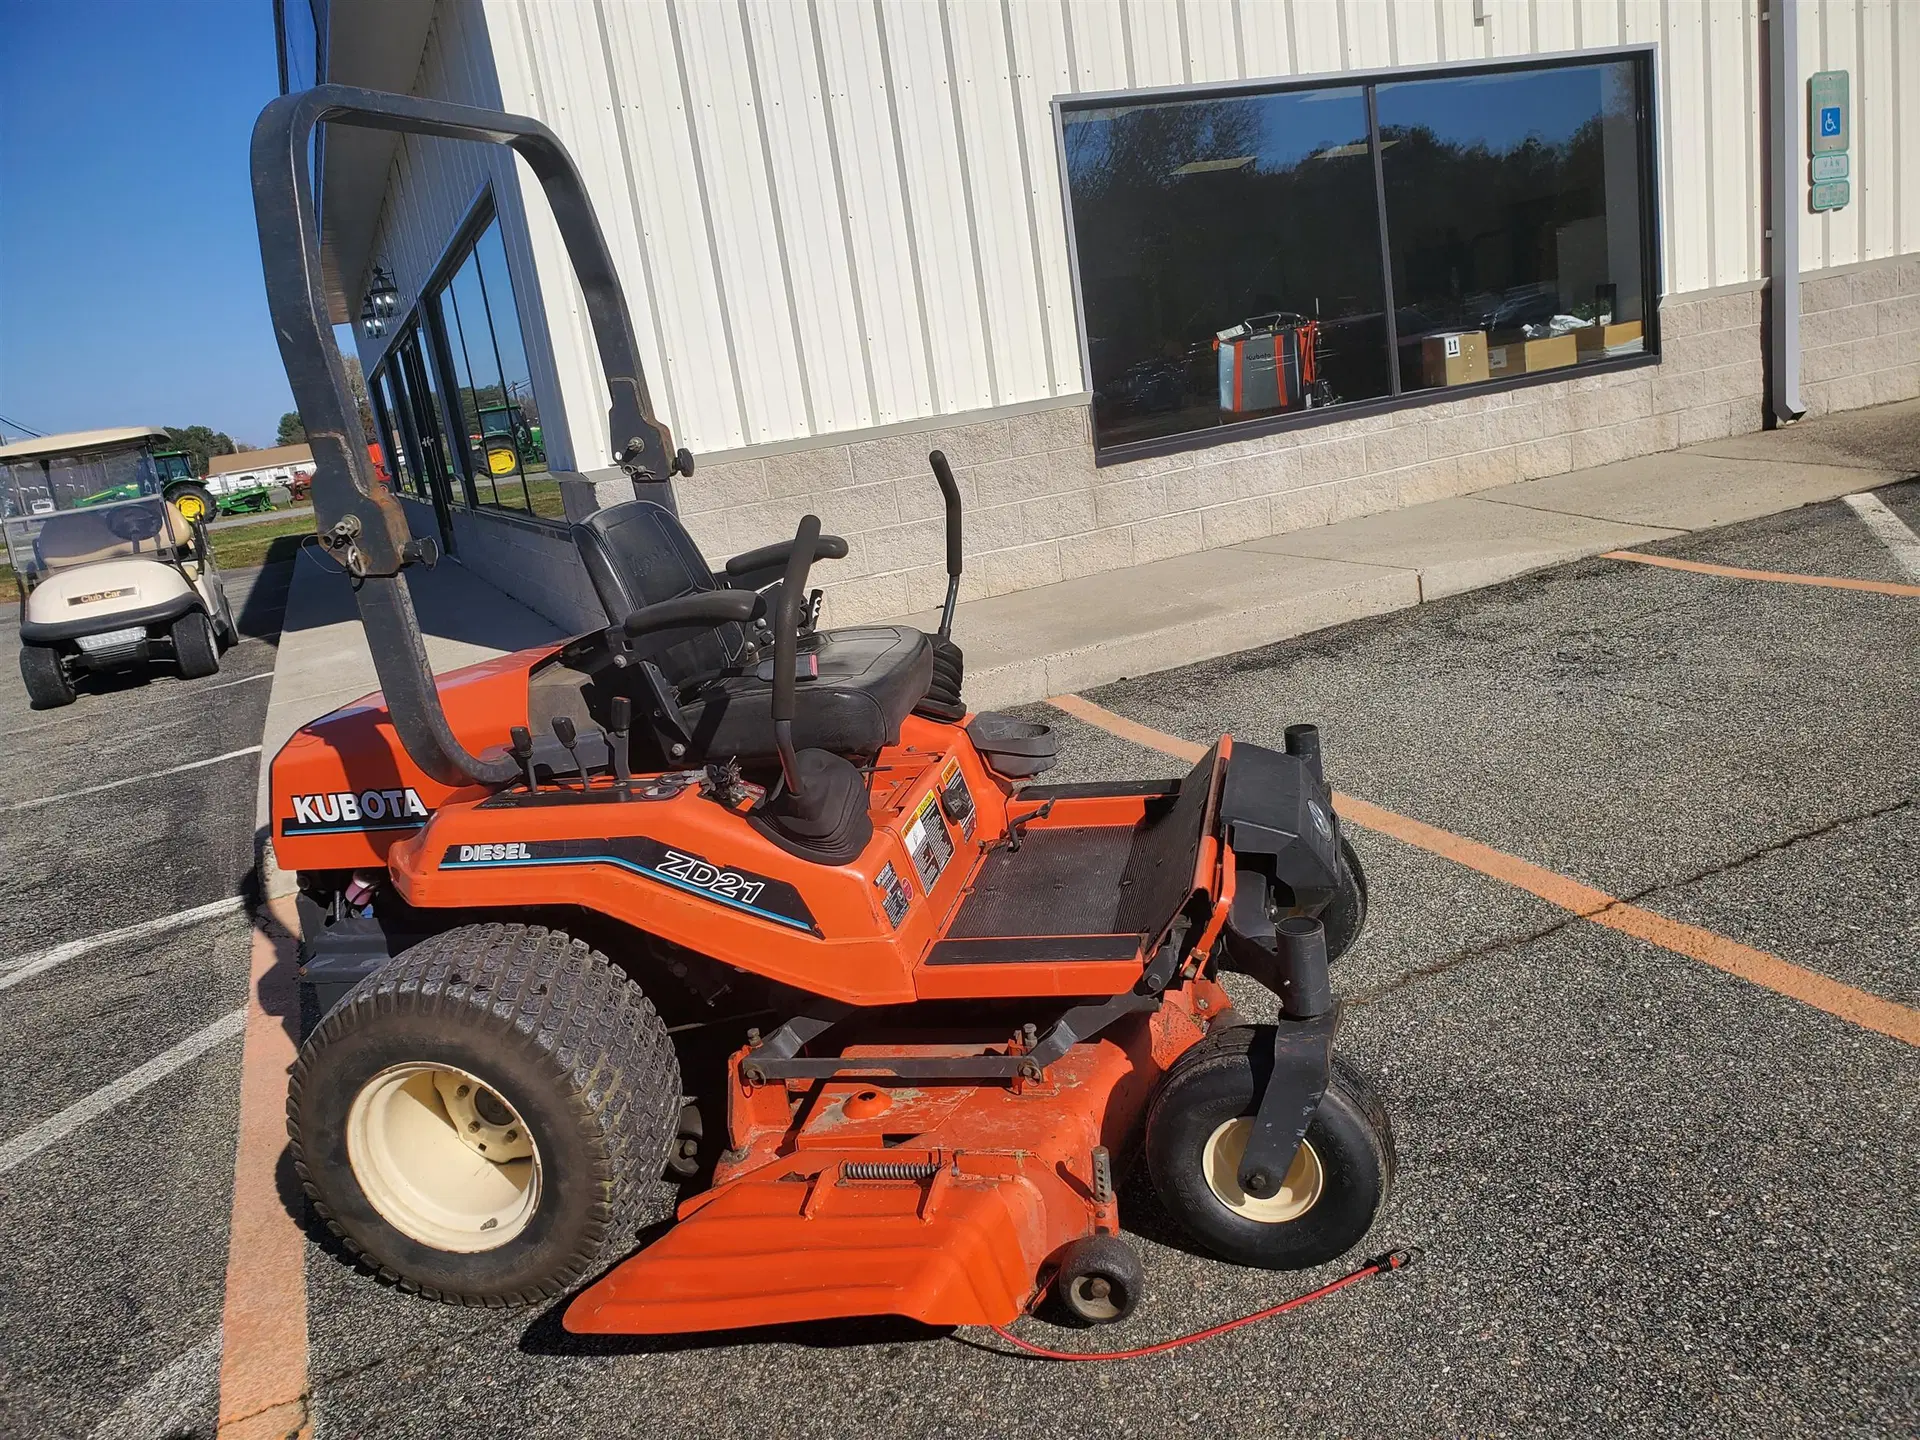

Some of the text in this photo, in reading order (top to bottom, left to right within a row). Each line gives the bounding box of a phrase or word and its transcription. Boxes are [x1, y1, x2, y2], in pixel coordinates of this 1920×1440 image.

[1823, 159, 1840, 168] VAN
[80, 590, 121, 603] Club Car
[292, 788, 429, 824] KUBOTA
[459, 843, 531, 862] DIESEL
[655, 850, 766, 904] ZD21
